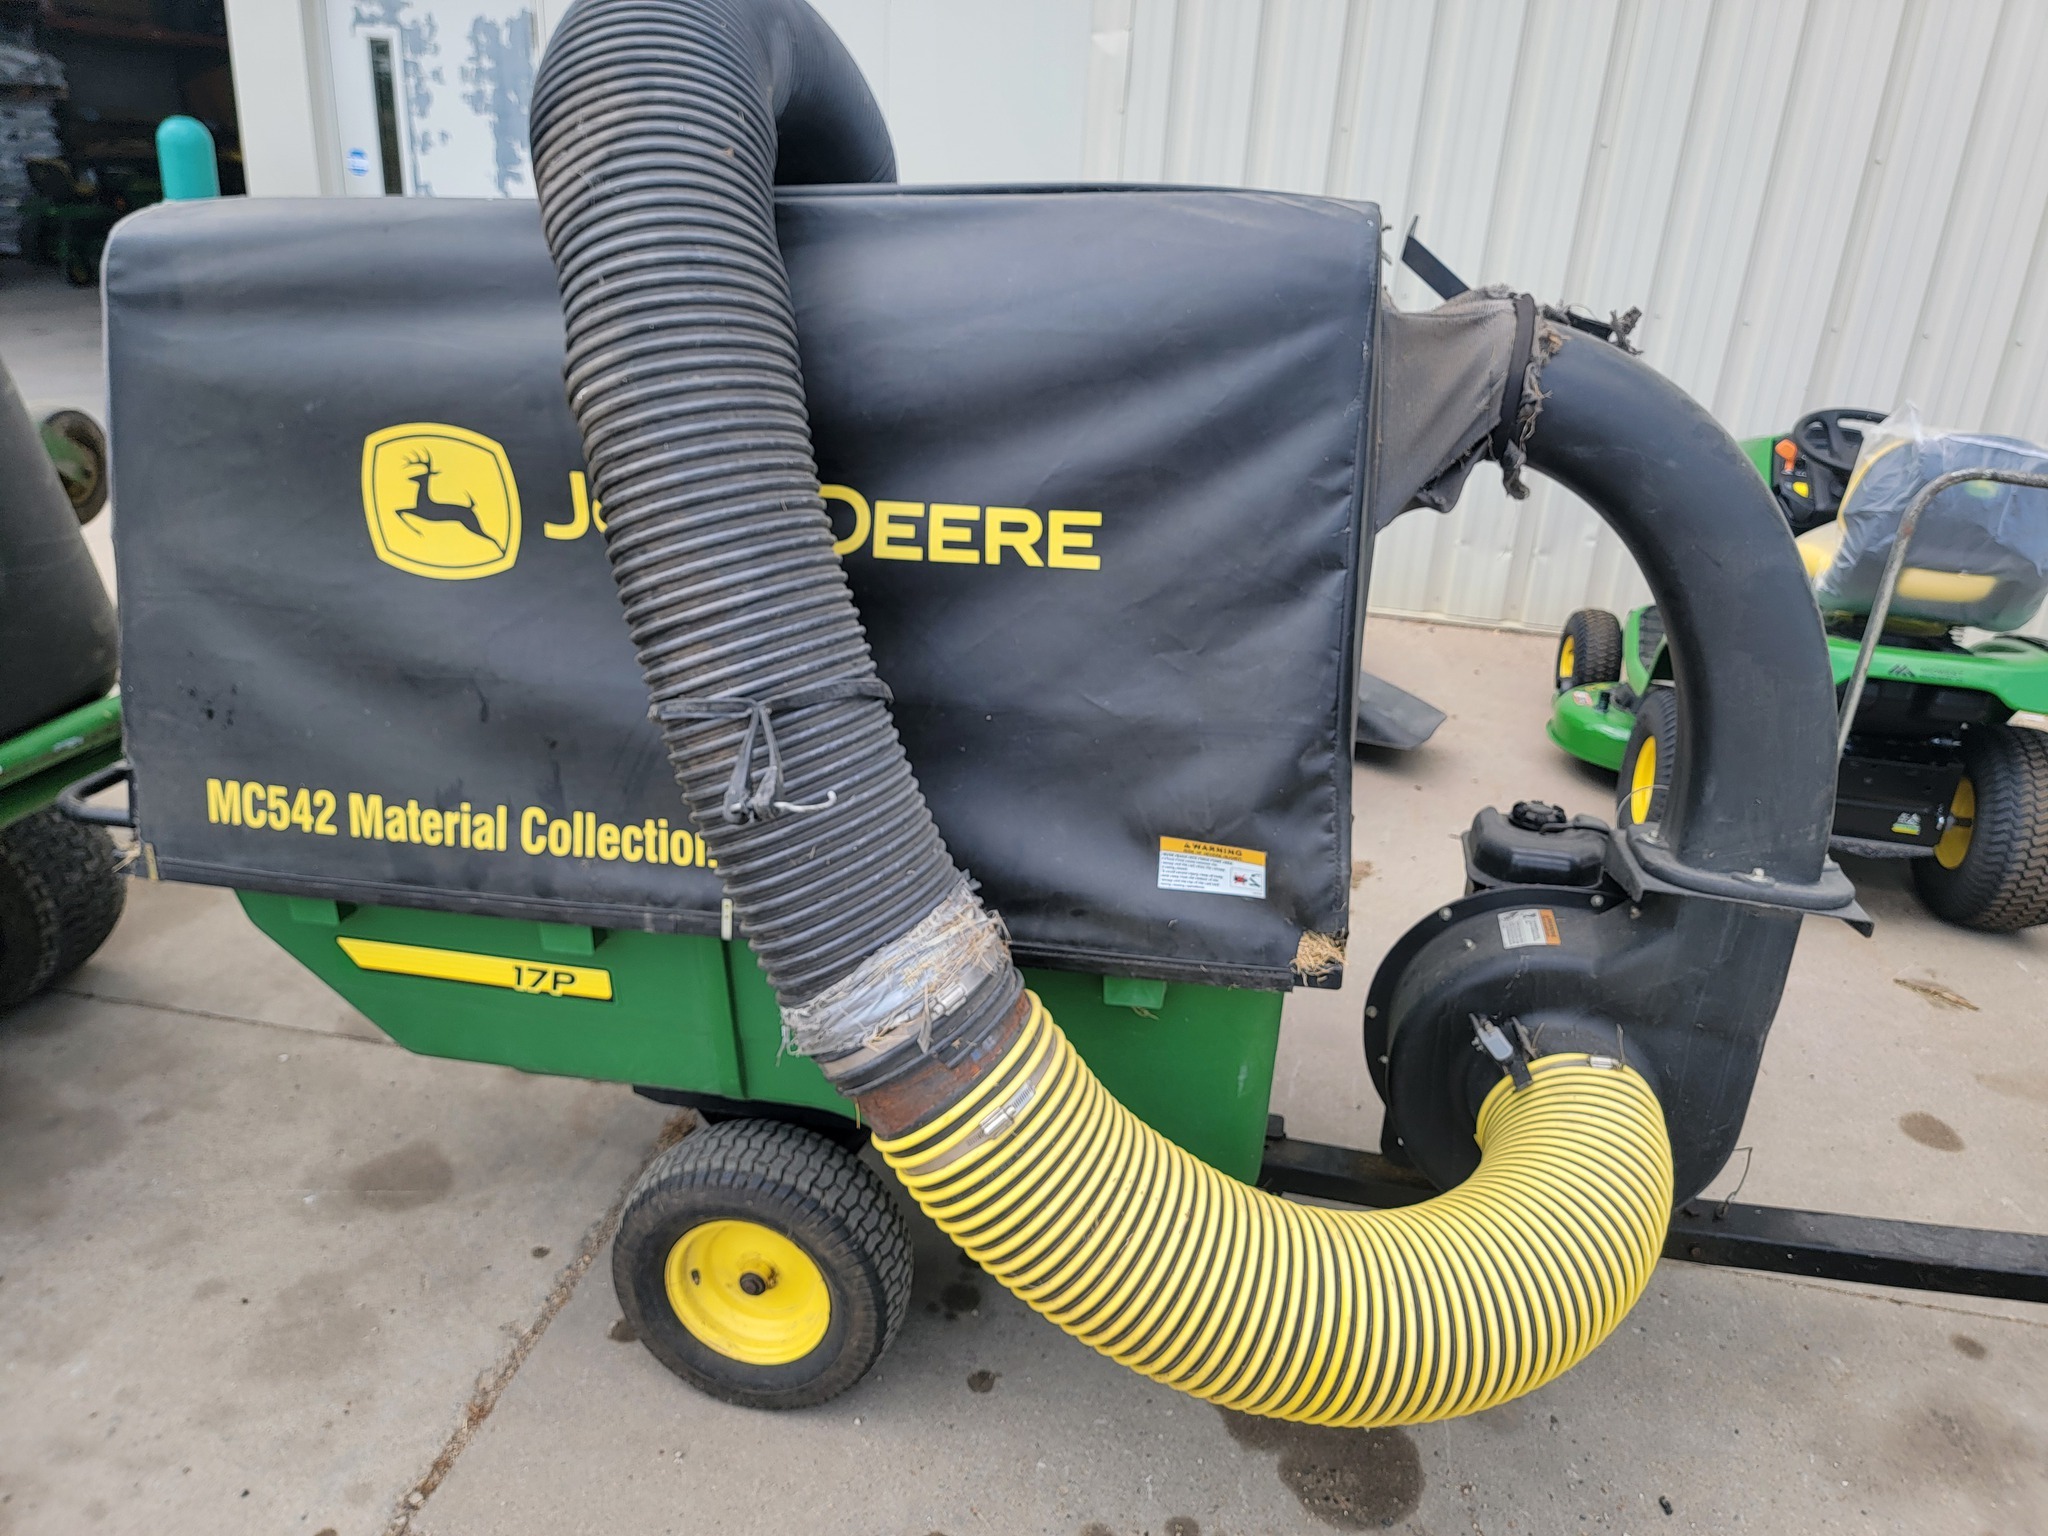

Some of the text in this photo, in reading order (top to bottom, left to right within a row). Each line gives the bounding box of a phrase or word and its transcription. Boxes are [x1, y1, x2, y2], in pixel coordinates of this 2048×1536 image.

[818, 484, 1103, 570] DEERE
[206, 777, 338, 836] MC542
[348, 792, 508, 852] Material
[1193, 842, 1242, 857] WARNING
[514, 966, 575, 990] 17P
